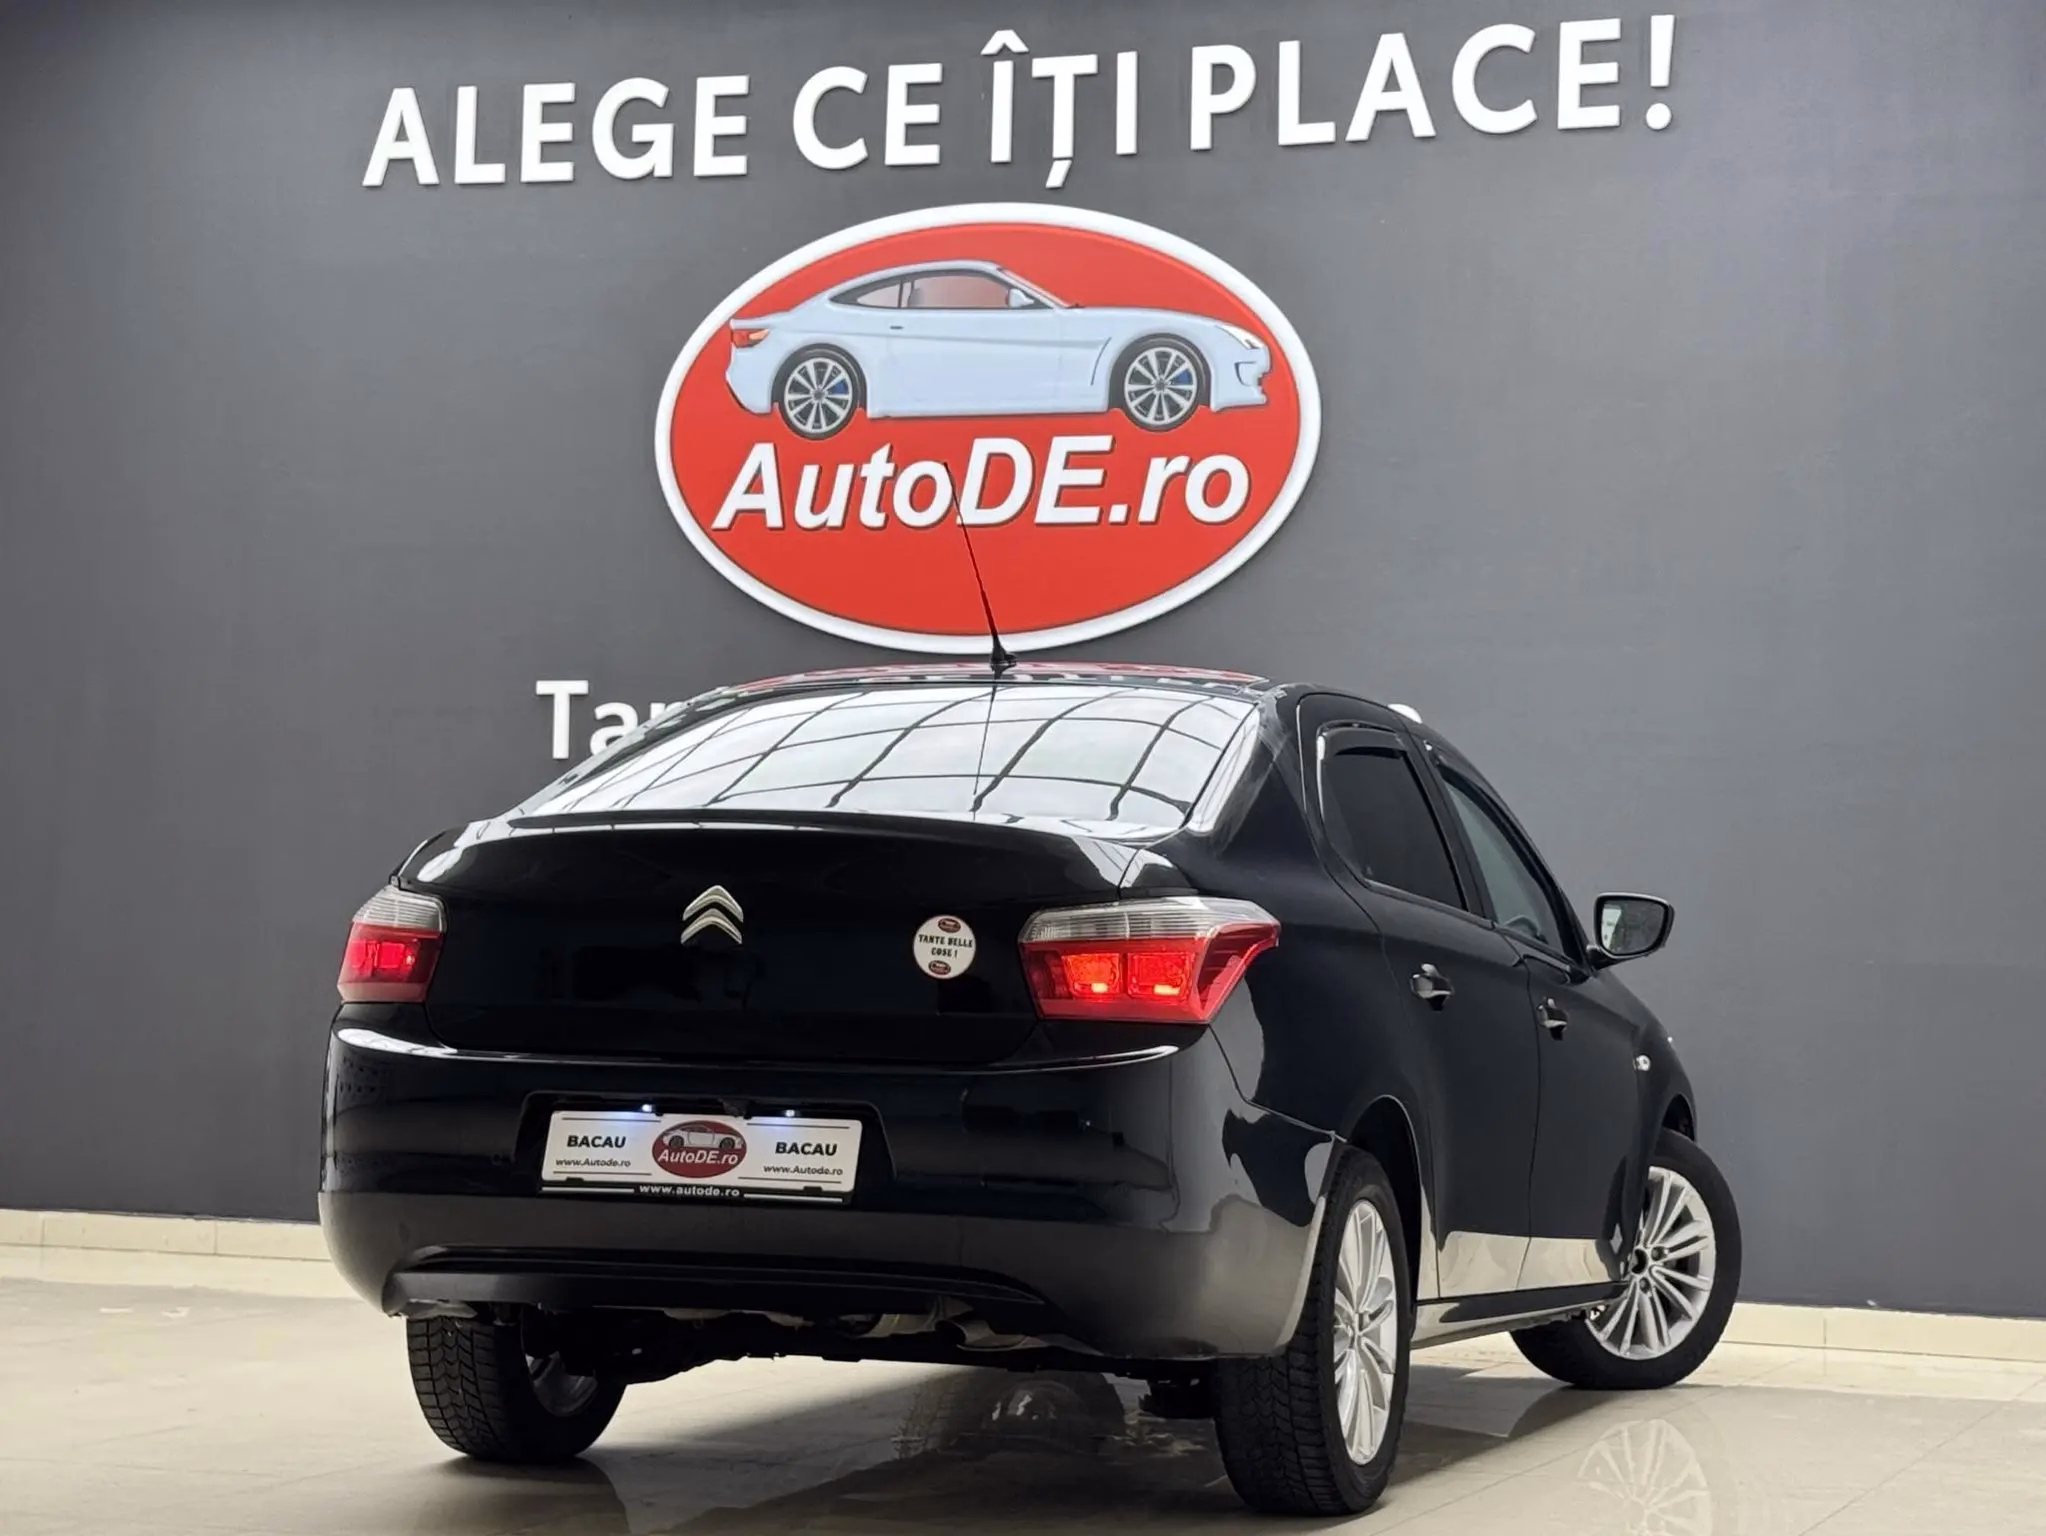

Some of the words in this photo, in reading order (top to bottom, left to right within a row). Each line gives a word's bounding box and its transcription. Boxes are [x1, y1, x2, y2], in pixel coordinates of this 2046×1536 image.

[363, 75, 749, 187] ALEGE
[793, 64, 942, 170] CE
[1190, 14, 1674, 150] PLACE!
[711, 433, 1250, 530] AutoDE.ro
[919, 934, 945, 944] TANTE
[566, 1135, 626, 1149] BACAU
[657, 1147, 739, 1166] AutoDE.ro
[775, 1142, 838, 1157] BACAU
[555, 1157, 631, 1168] www.Autode.ro
[763, 1165, 843, 1176] www.Autode.ro
[639, 1184, 740, 1197] www.autode.ro
